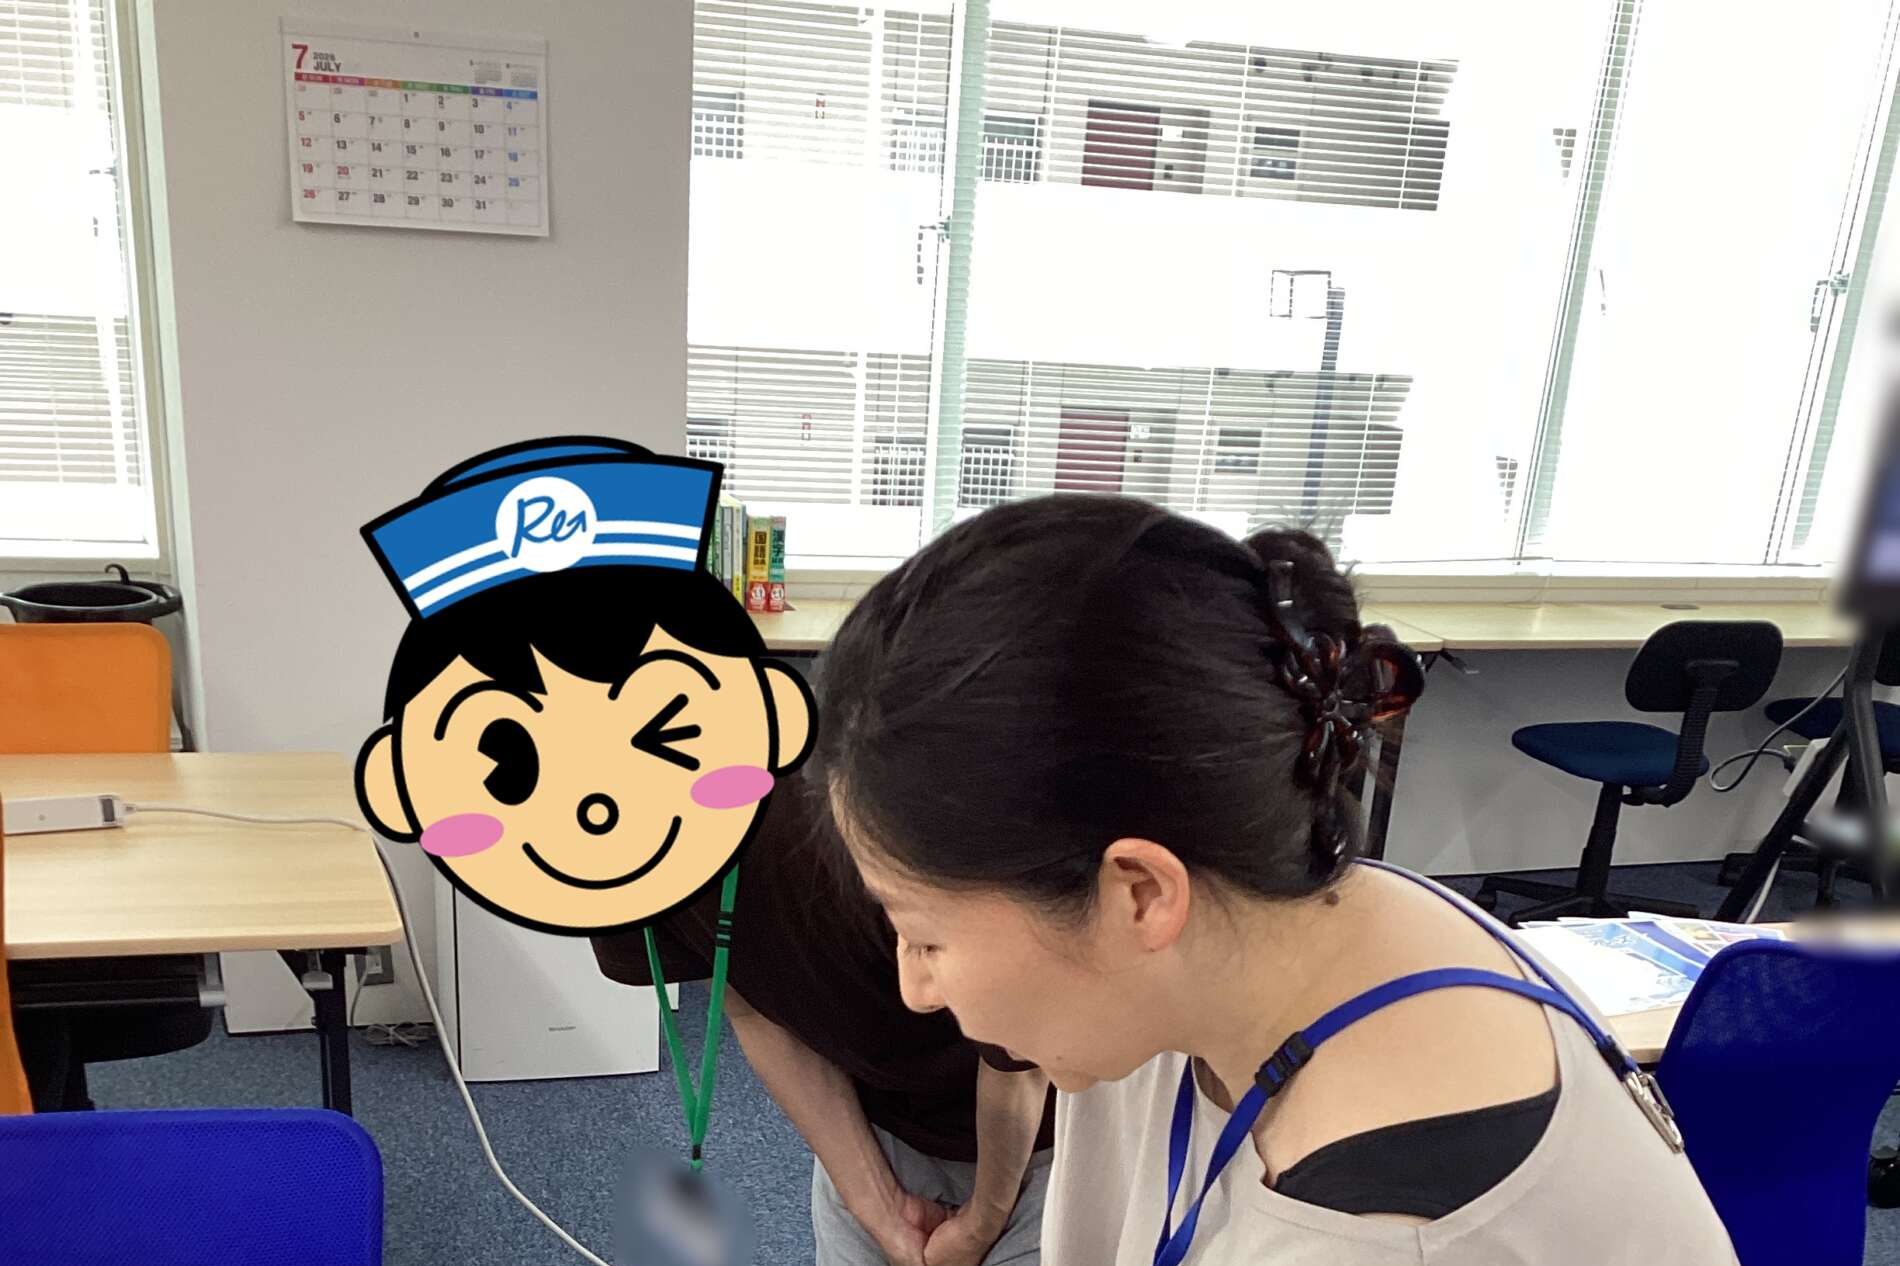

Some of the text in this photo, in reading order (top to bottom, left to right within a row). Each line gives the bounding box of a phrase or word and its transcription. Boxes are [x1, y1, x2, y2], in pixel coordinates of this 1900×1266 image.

[291, 43, 308, 69] 7
[313, 62, 341, 72] JULY
[404, 93, 408, 102] 1
[438, 95, 444, 105] 2
[472, 98, 478, 108] 3
[298, 111, 517, 136] 5 6 7 8 9 10 11
[301, 137, 312, 147] 12
[336, 140, 347, 149] 13
[372, 143, 382, 152] 14
[406, 145, 417, 154] 15
[440, 148, 451, 157] 16
[474, 150, 484, 159] 17
[303, 163, 313, 173] 19
[337, 166, 349, 176] 20
[372, 168, 383, 178] 21
[406, 171, 418, 180] 22
[440, 173, 453, 183] 23
[474, 175, 486, 185] 24
[338, 192, 350, 201] 27
[408, 196, 419, 205] 29
[442, 198, 454, 208] 30
[475, 200, 486, 210] 31
